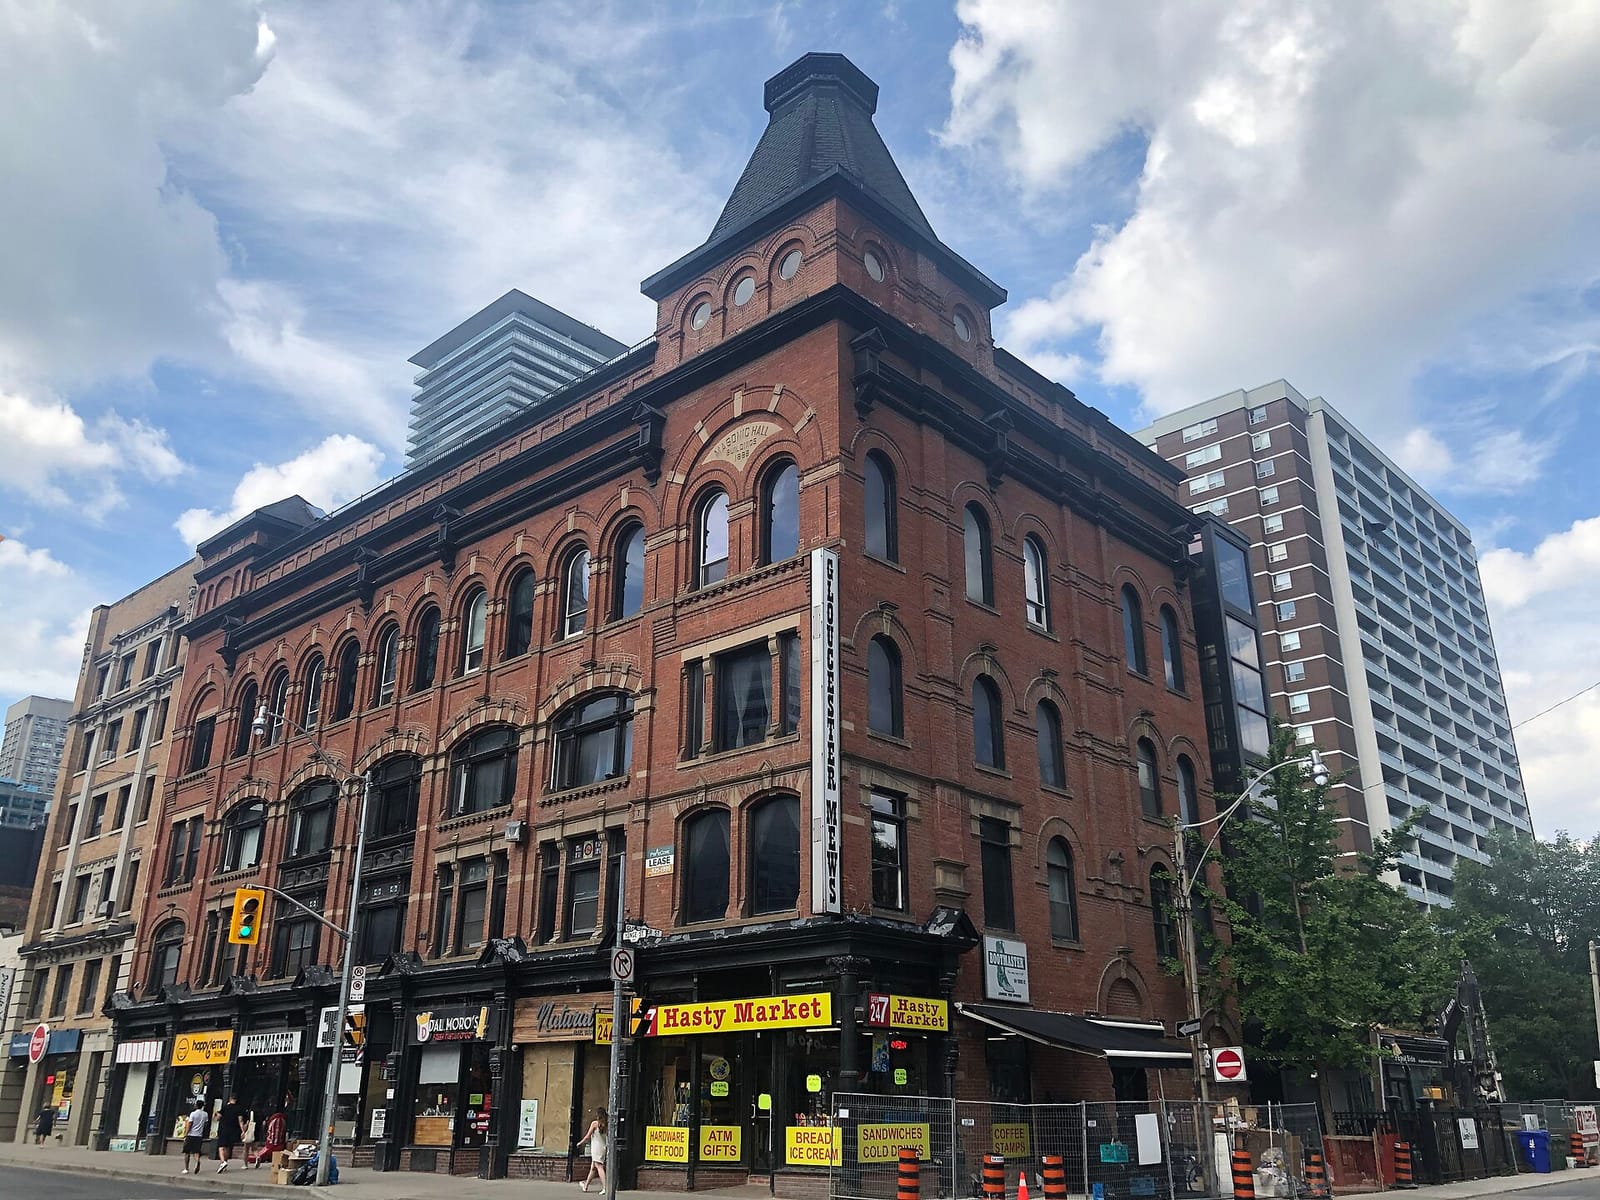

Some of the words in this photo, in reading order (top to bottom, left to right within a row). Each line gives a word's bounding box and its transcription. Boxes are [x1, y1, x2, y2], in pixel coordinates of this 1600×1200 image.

[751, 425, 769, 436] HALL
[826, 799, 837, 904] MEWS
[649, 855, 671, 866] LEASE
[664, 1006, 726, 1029] Hasty
[734, 998, 821, 1023] Market
[897, 999, 939, 1016] Hasty
[429, 1019, 446, 1032] DAL
[446, 1015, 479, 1031] MORO'S
[892, 1012, 945, 1027] Market
[246, 1033, 294, 1054] BOOTMASTER
[650, 1130, 685, 1143] HARDWARE
[708, 1130, 733, 1142] ATM
[796, 1132, 832, 1144] BREAD
[863, 1128, 922, 1140] SANDWICHES
[995, 1128, 1024, 1139] COFFEE
[650, 1145, 663, 1156] PET
[664, 1146, 684, 1157] FOOD
[703, 1144, 737, 1157] GIFTS
[790, 1147, 804, 1159] ICE
[806, 1147, 838, 1160] CREAM
[863, 1145, 889, 1158] COLD
[995, 1142, 1026, 1153] STAMPS
